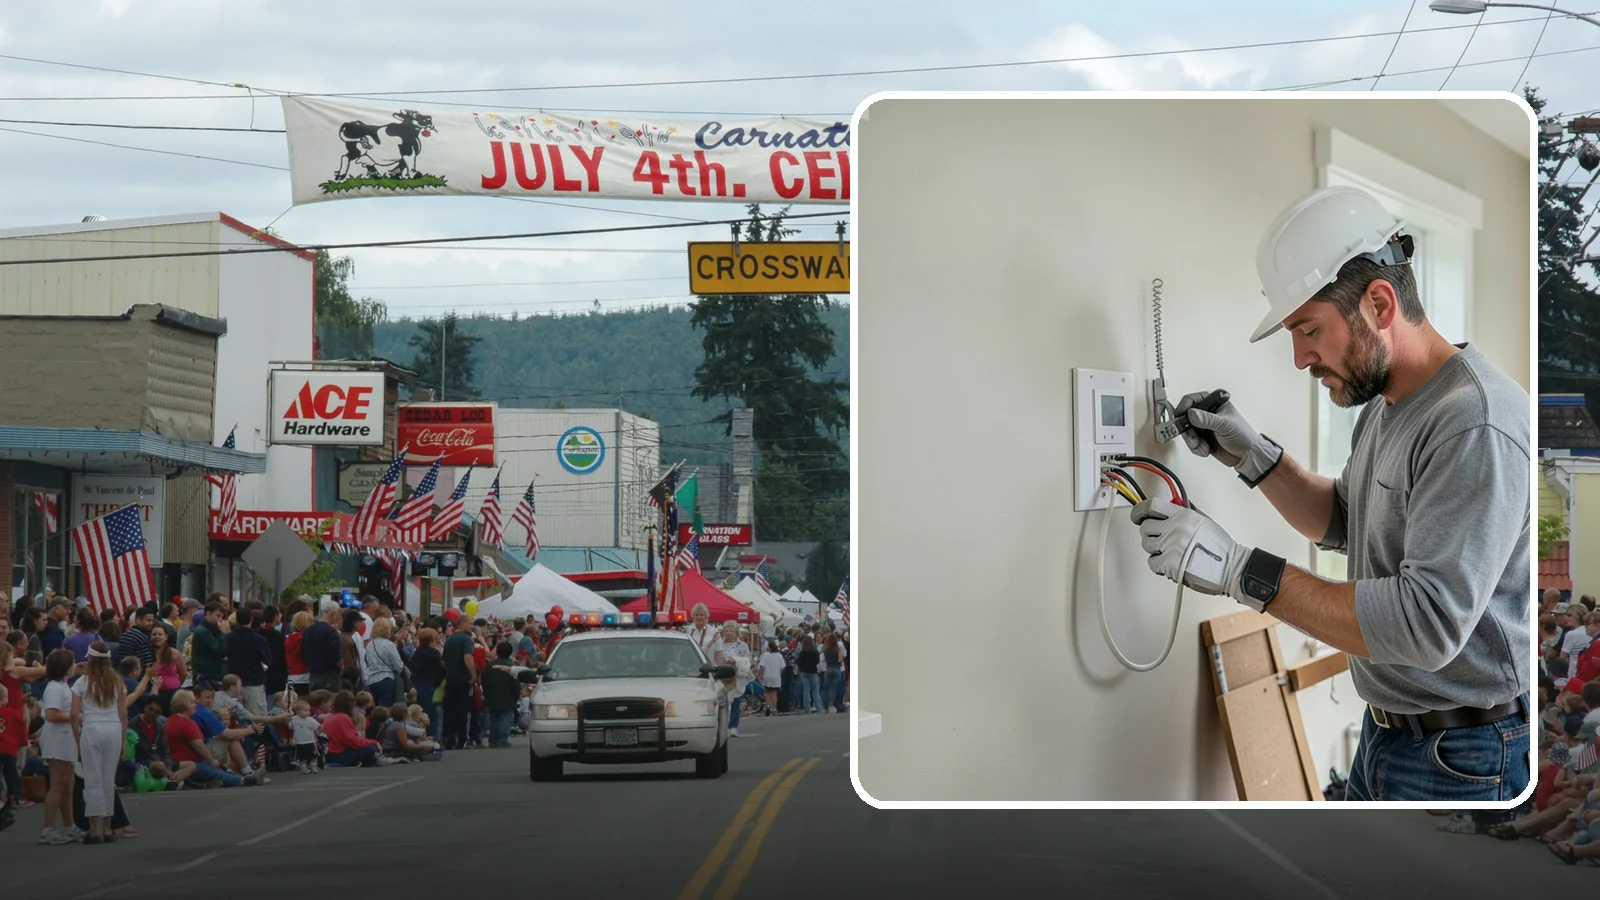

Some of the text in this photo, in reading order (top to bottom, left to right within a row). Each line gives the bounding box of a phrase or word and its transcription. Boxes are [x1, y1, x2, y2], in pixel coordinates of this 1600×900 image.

[481, 140, 605, 192] JULY
[632, 149, 747, 198] 4th.
[697, 254, 850, 280] CROSSWA
[283, 380, 373, 420] ACE
[405, 409, 453, 422] CEDAR
[283, 421, 371, 436] Hardware
[416, 428, 477, 447] Coca-Cola
[353, 467, 386, 480] Simpl
[94, 485, 124, 495] Vincent
[126, 486, 136, 495] de
[137, 486, 155, 495] Paul
[81, 503, 154, 522] THT
[212, 515, 331, 536] HARDARE
[688, 526, 741, 535] CRNATION
[699, 535, 730, 544] GLASS
